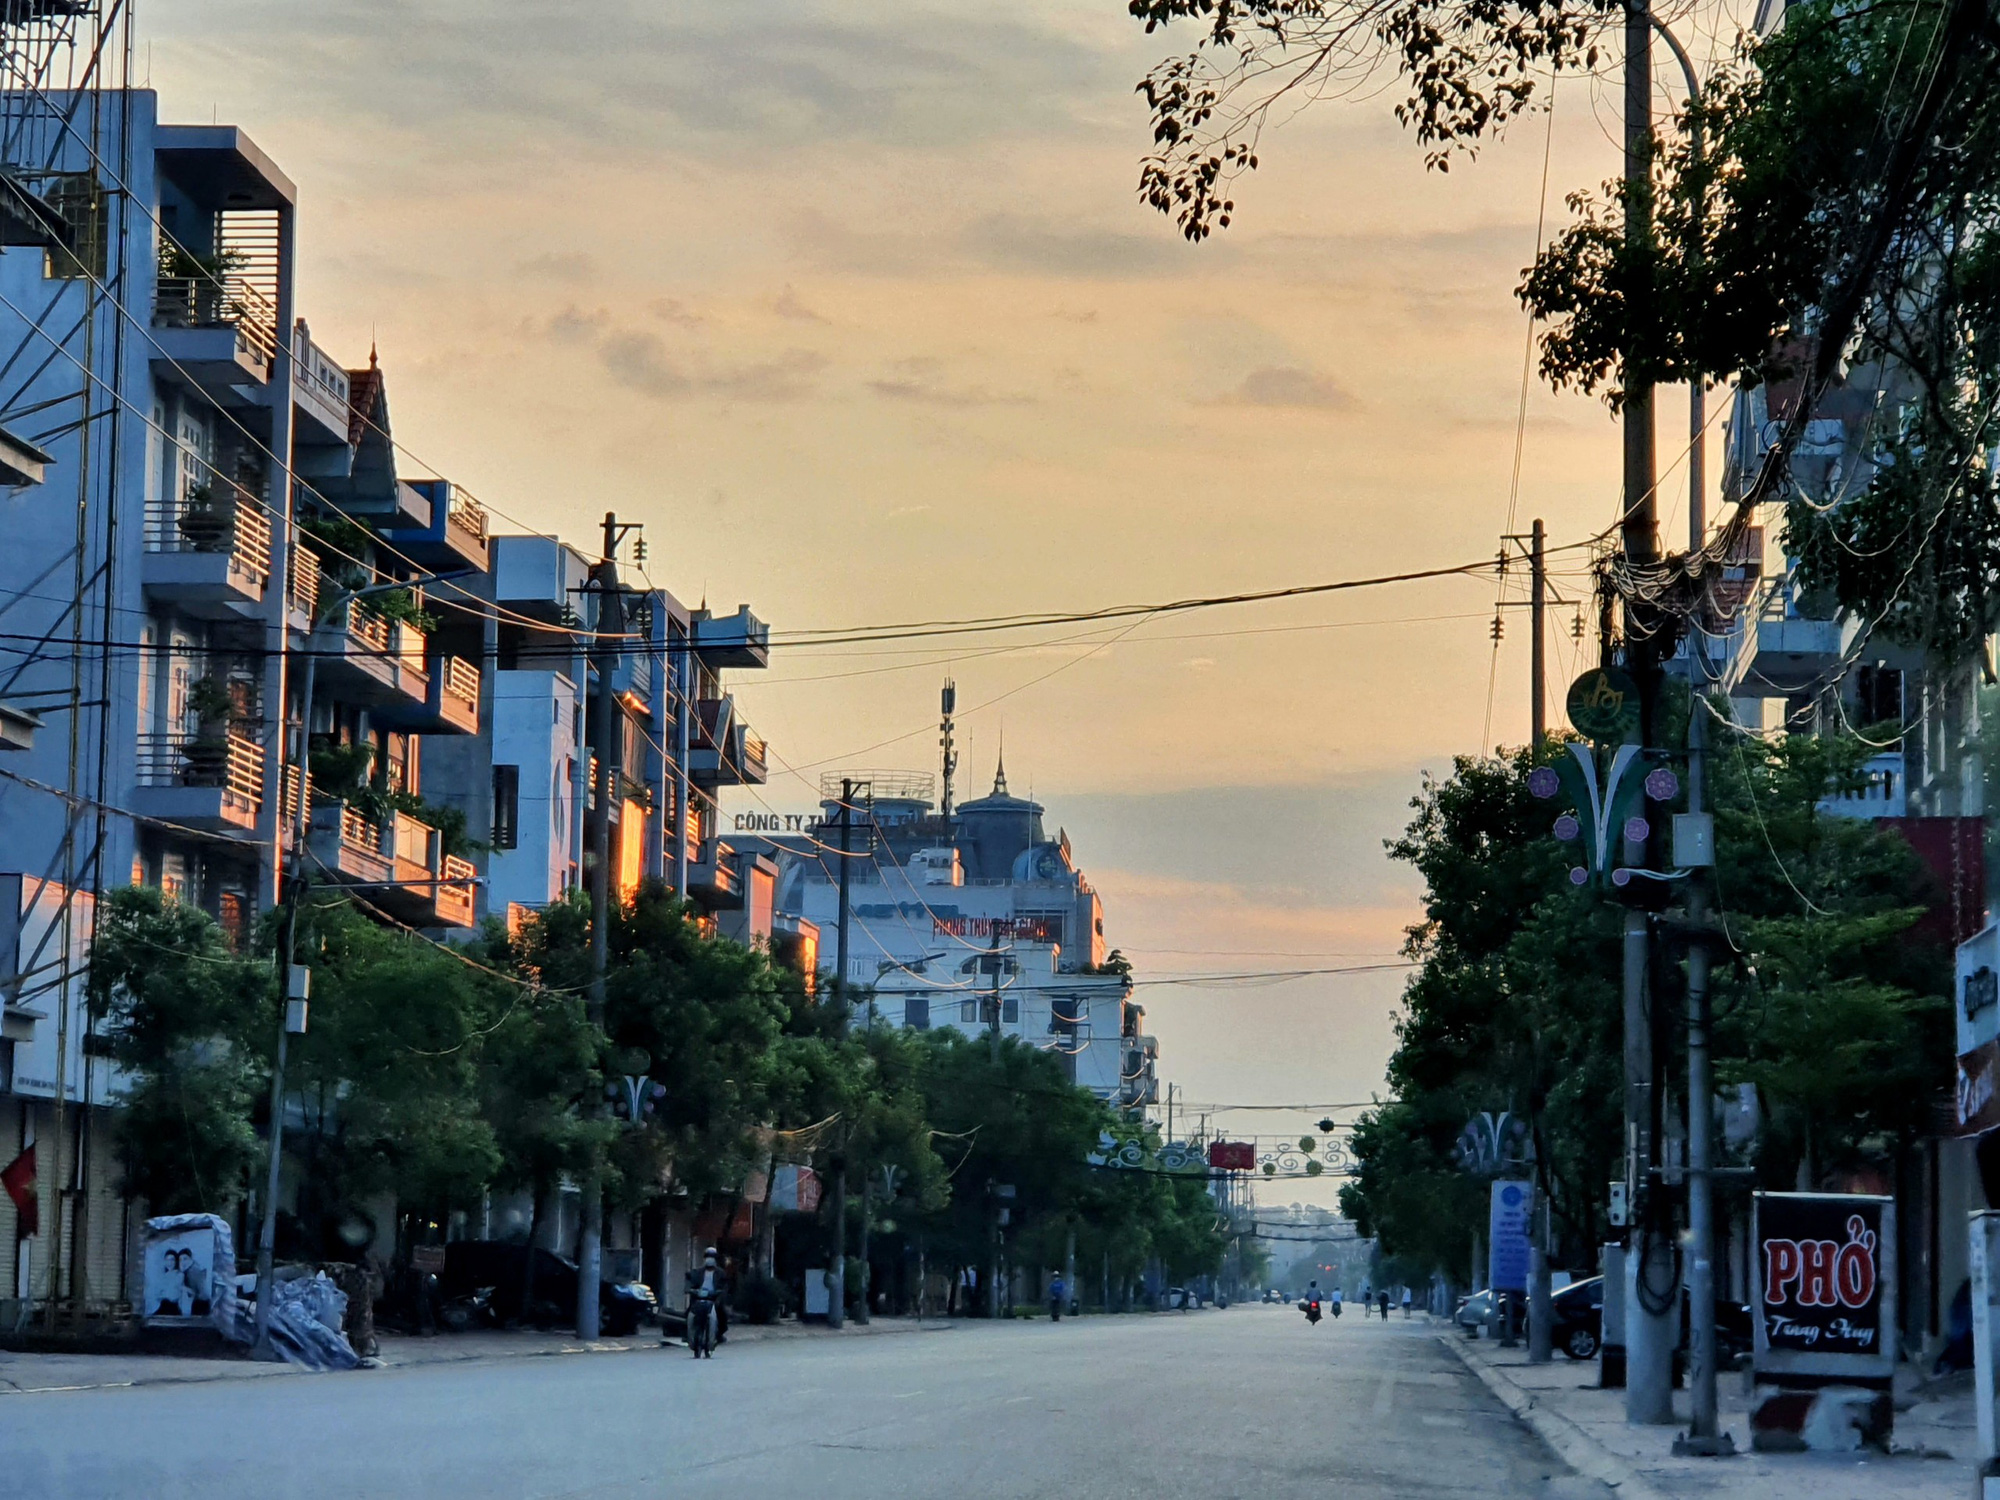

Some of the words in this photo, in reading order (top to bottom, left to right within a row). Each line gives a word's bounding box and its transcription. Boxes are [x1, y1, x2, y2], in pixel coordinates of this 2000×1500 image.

[735, 810, 780, 831] CÔNG
[785, 814, 803, 831] TY
[932, 917, 966, 937] PHONG
[1763, 1214, 1876, 1309] PHỞ
